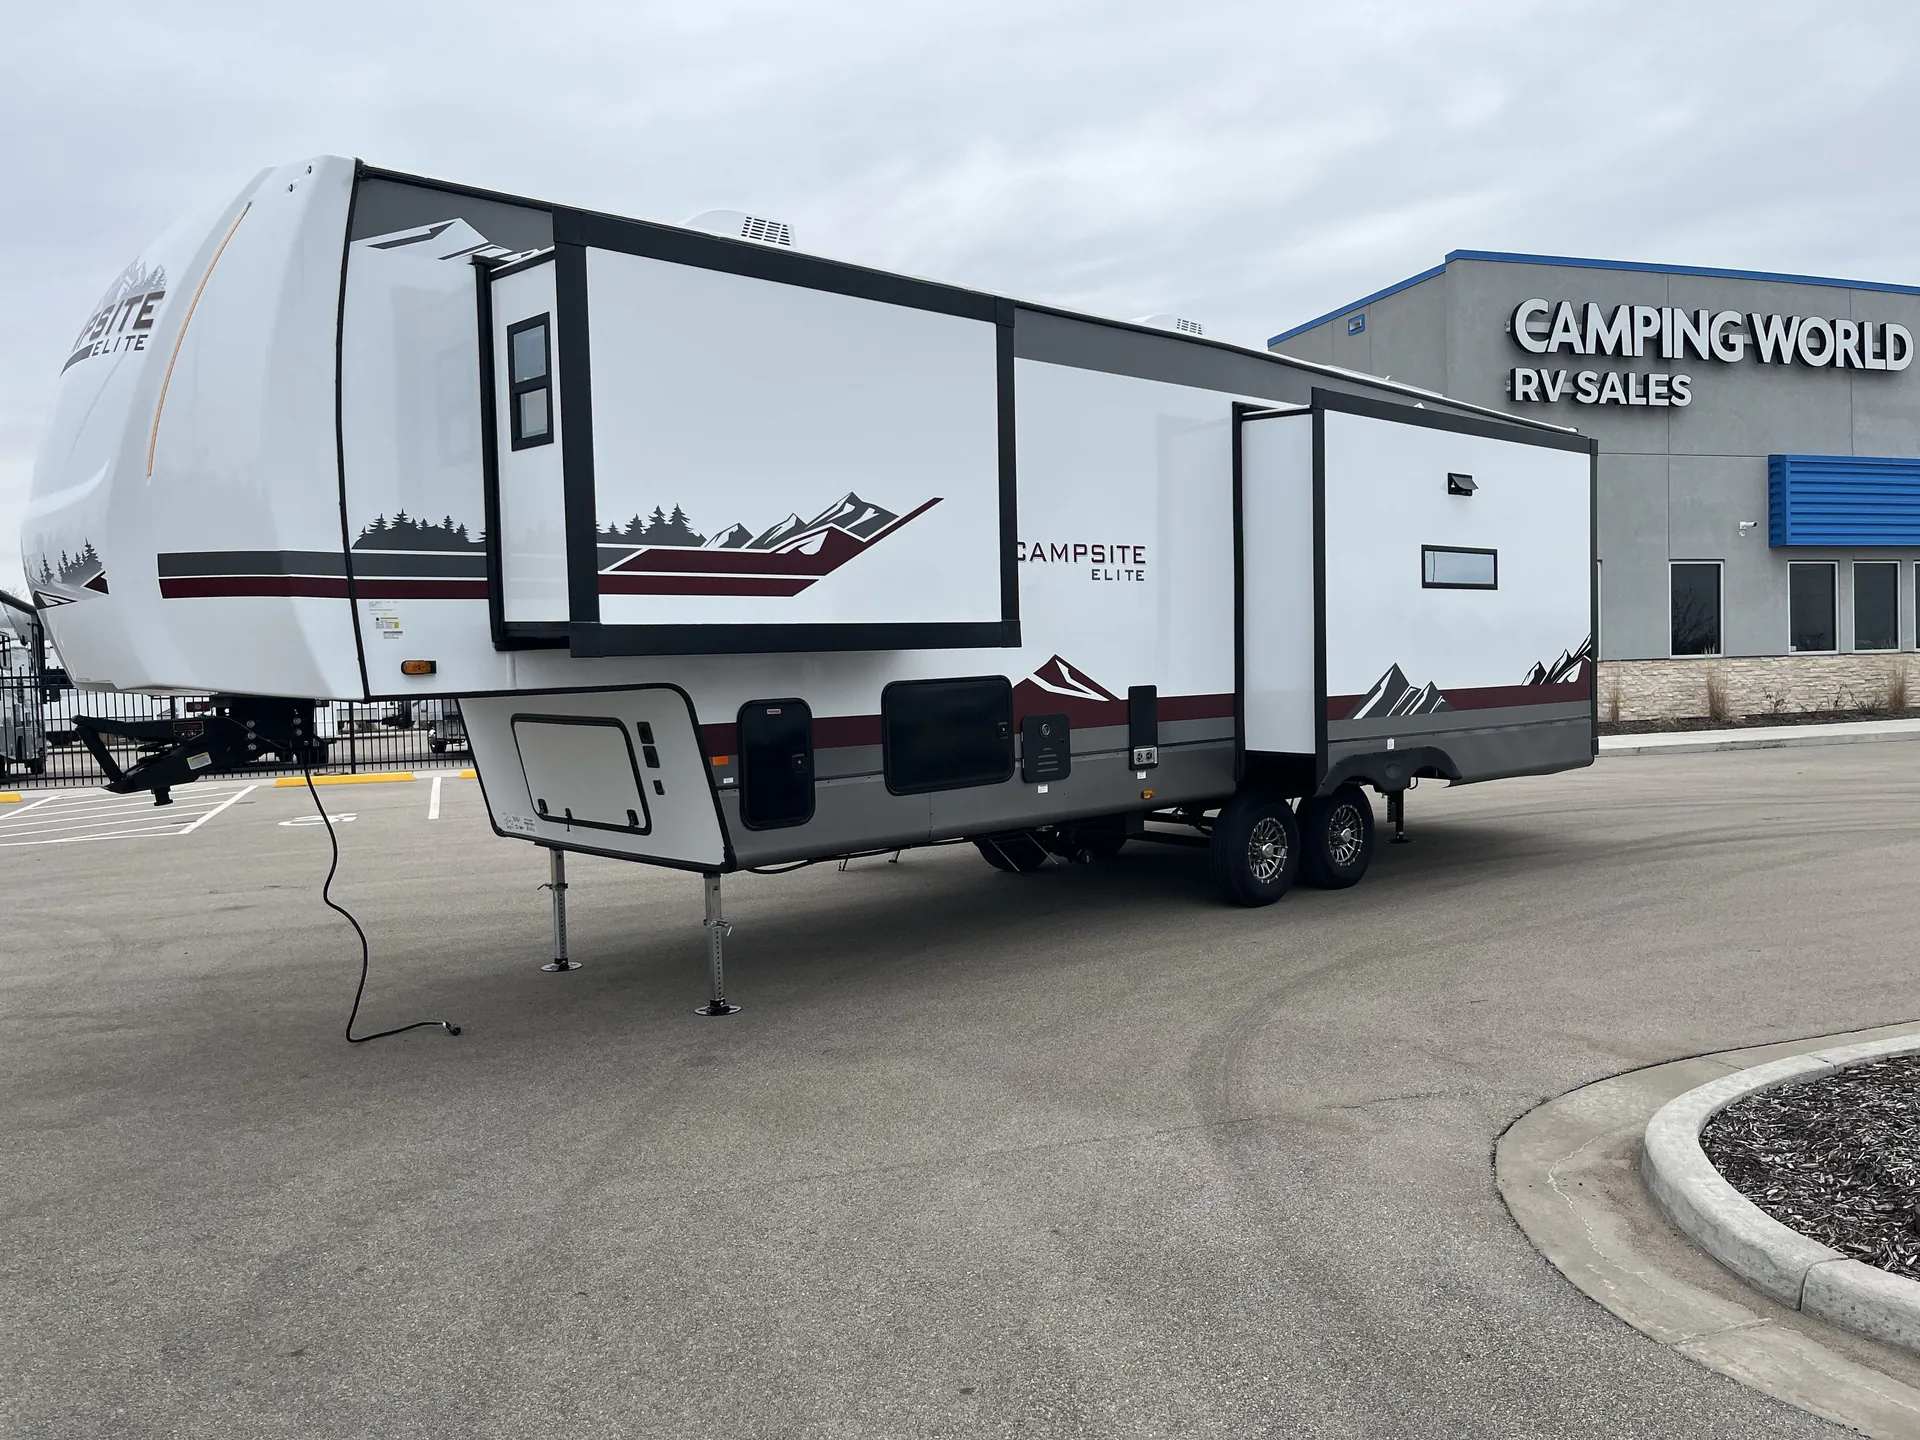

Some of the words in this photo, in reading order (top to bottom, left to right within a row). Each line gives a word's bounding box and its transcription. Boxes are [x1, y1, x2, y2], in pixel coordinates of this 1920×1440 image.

[91, 334, 148, 357] ELITE
[1513, 298, 1744, 364] CAMPING
[1748, 311, 1915, 371] WORLD
[1513, 367, 1568, 402] RV
[1575, 370, 1693, 408] SALES
[1091, 568, 1145, 581] ELITE
